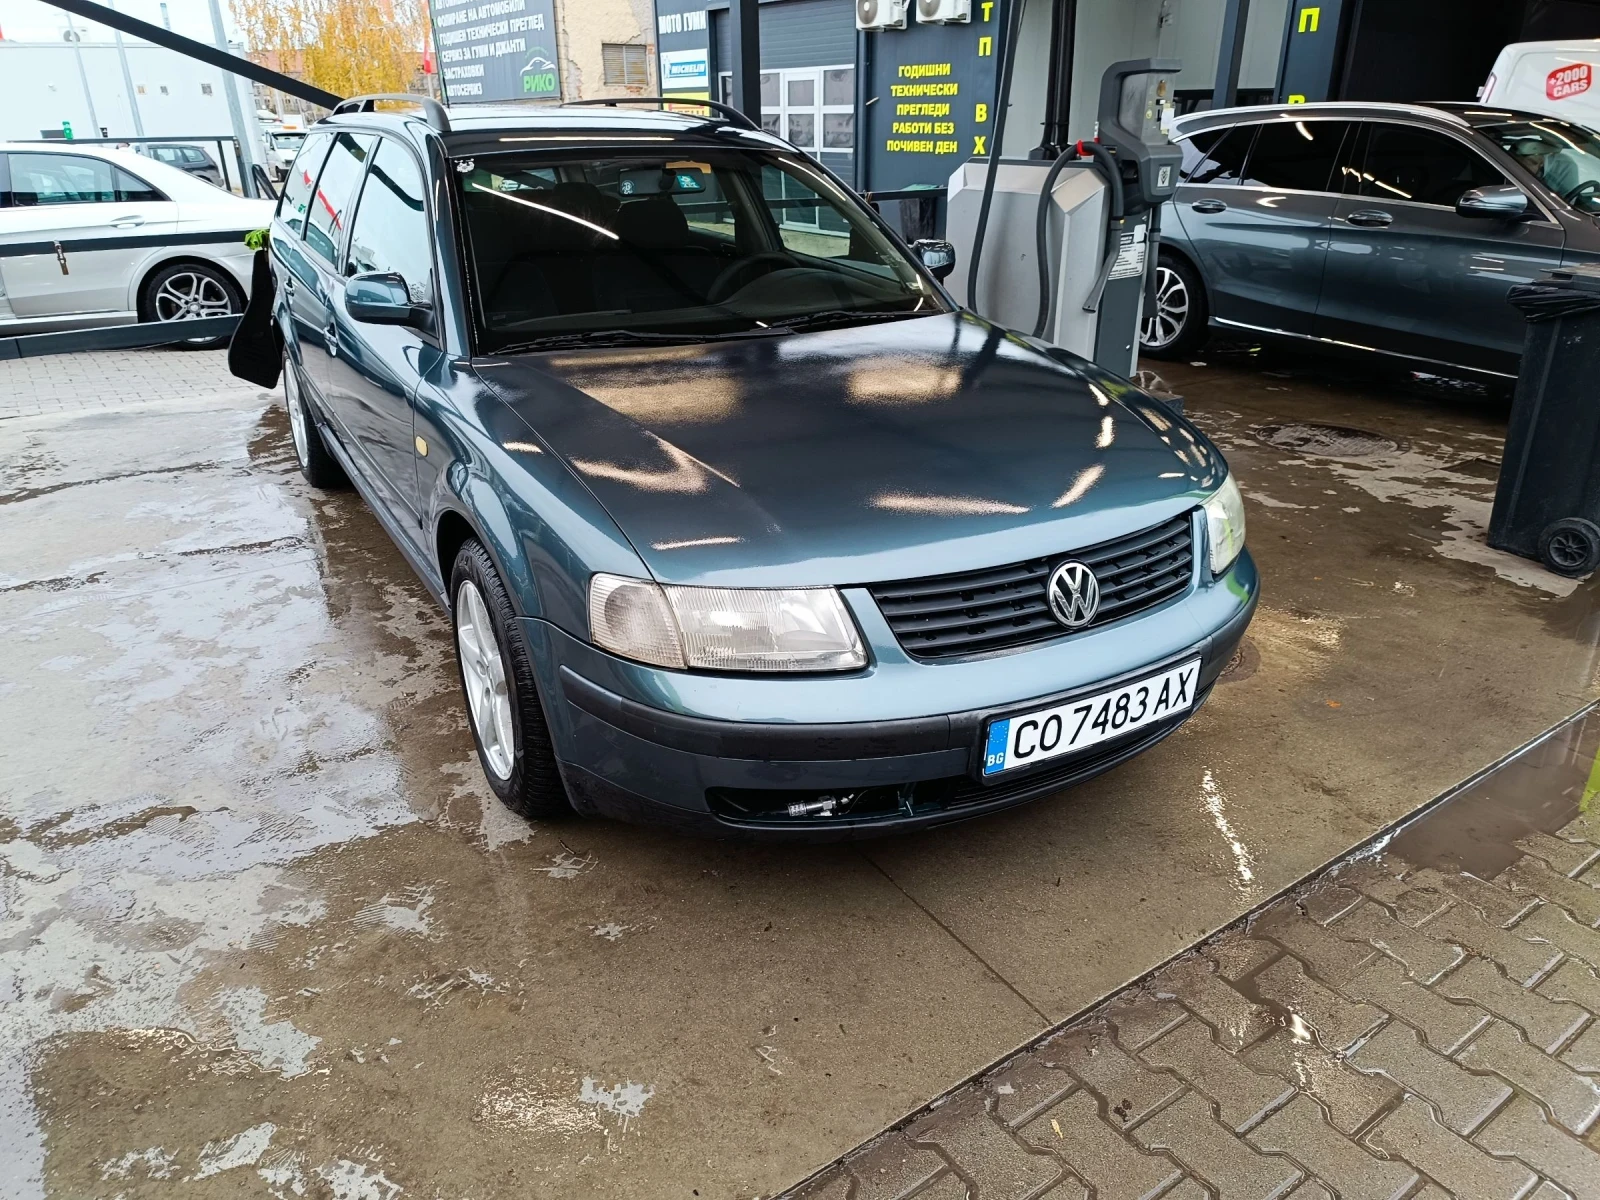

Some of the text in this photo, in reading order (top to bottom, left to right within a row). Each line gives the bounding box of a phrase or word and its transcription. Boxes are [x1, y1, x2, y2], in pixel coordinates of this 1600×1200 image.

[468, 7, 478, 22] НА
[478, 0, 525, 19] АВТОМОБИЛИ
[467, 20, 509, 40] ТЕХНИЧЕСКИ
[510, 14, 544, 31] ПРЕГЛЕД
[658, 10, 707, 34] МОТО ГУМИ
[442, 38, 526, 62] СЕРВИЗ ЗА ГУМИ И ДЖАНТИ
[443, 64, 484, 80] ЗАСТРАХОВКИ
[671, 63, 705, 75] MICHELIN
[898, 63, 951, 78] ГОДИШНИ
[1548, 65, 1588, 86] +2000
[447, 82, 483, 97] АВТОСЕРВИЗ
[524, 73, 555, 93] РИКО
[890, 83, 958, 97] ТЕХНИЧЕСКИ
[1553, 79, 1588, 97] CARS
[896, 103, 950, 117] ПРЕГЛЕДИ
[892, 122, 954, 134] РАБОТИ БЕЗ
[887, 140, 957, 154] ПОЧИВЕН ДЕН
[1069, 686, 1149, 746] 7483
[987, 752, 1004, 767] BG
